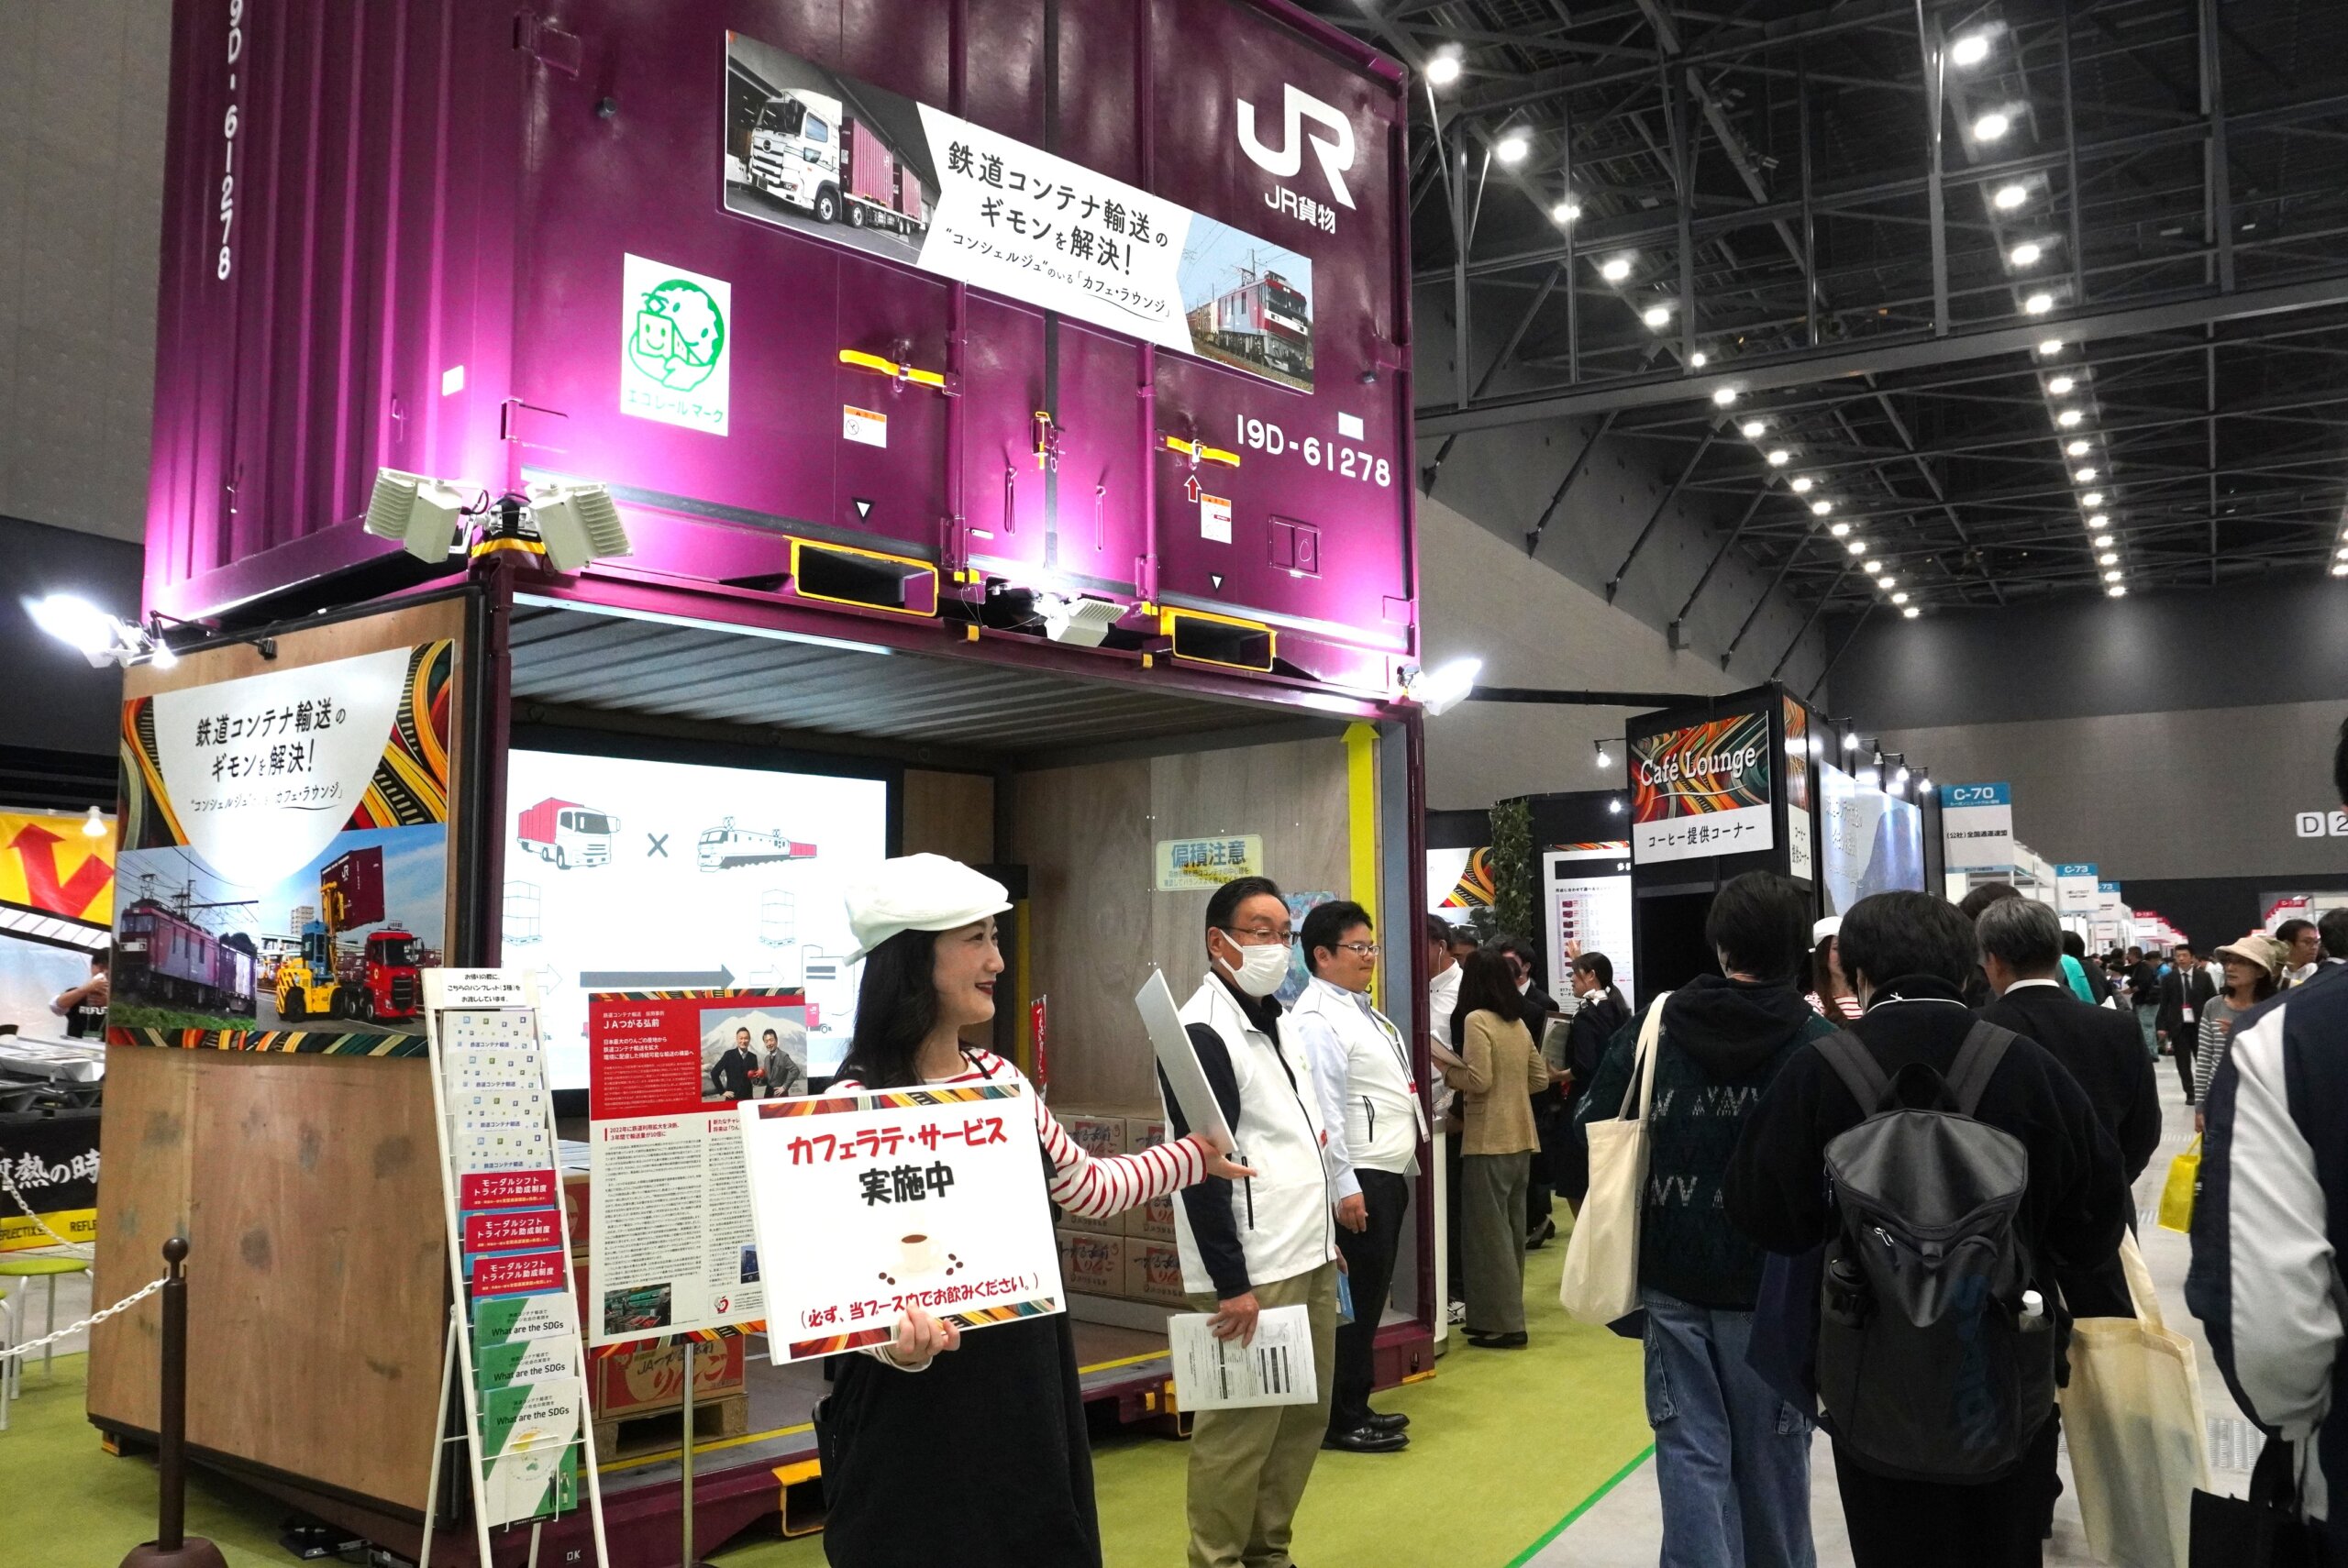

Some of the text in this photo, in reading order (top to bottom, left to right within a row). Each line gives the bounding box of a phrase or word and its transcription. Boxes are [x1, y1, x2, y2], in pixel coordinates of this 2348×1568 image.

[1237, 83, 1356, 210] JR
[947, 140, 1168, 248] 鉄道コンテナ輸送の
[1264, 184, 1336, 235] JR貨物
[628, 389, 724, 423] エコレールマーク
[1237, 414, 1391, 488] 19D-61278
[195, 697, 347, 747] 鉄道コンテナ輸送の
[1640, 746, 1755, 787] Café Lounge
[1954, 787, 1994, 801] C-70
[1649, 823, 1755, 848] コーヒー提供コーナー
[1171, 840, 1246, 868] 偏積注意
[787, 1116, 1008, 1165] カフェラテ・サービス
[474, 1184, 548, 1197] トライアル助成制度
[482, 1177, 539, 1187] モーダルシフト
[858, 1160, 955, 1207] 実施中
[477, 1225, 550, 1239] トライアル助成制度
[485, 1218, 542, 1230] モーダルシフト
[482, 1267, 555, 1282] トライアル助成制度
[490, 1260, 547, 1273] モーダルシフト
[492, 1320, 564, 1337] What are the SDGs
[493, 1363, 566, 1381] What are the SDGs
[496, 1407, 570, 1426] What are the SDGs
